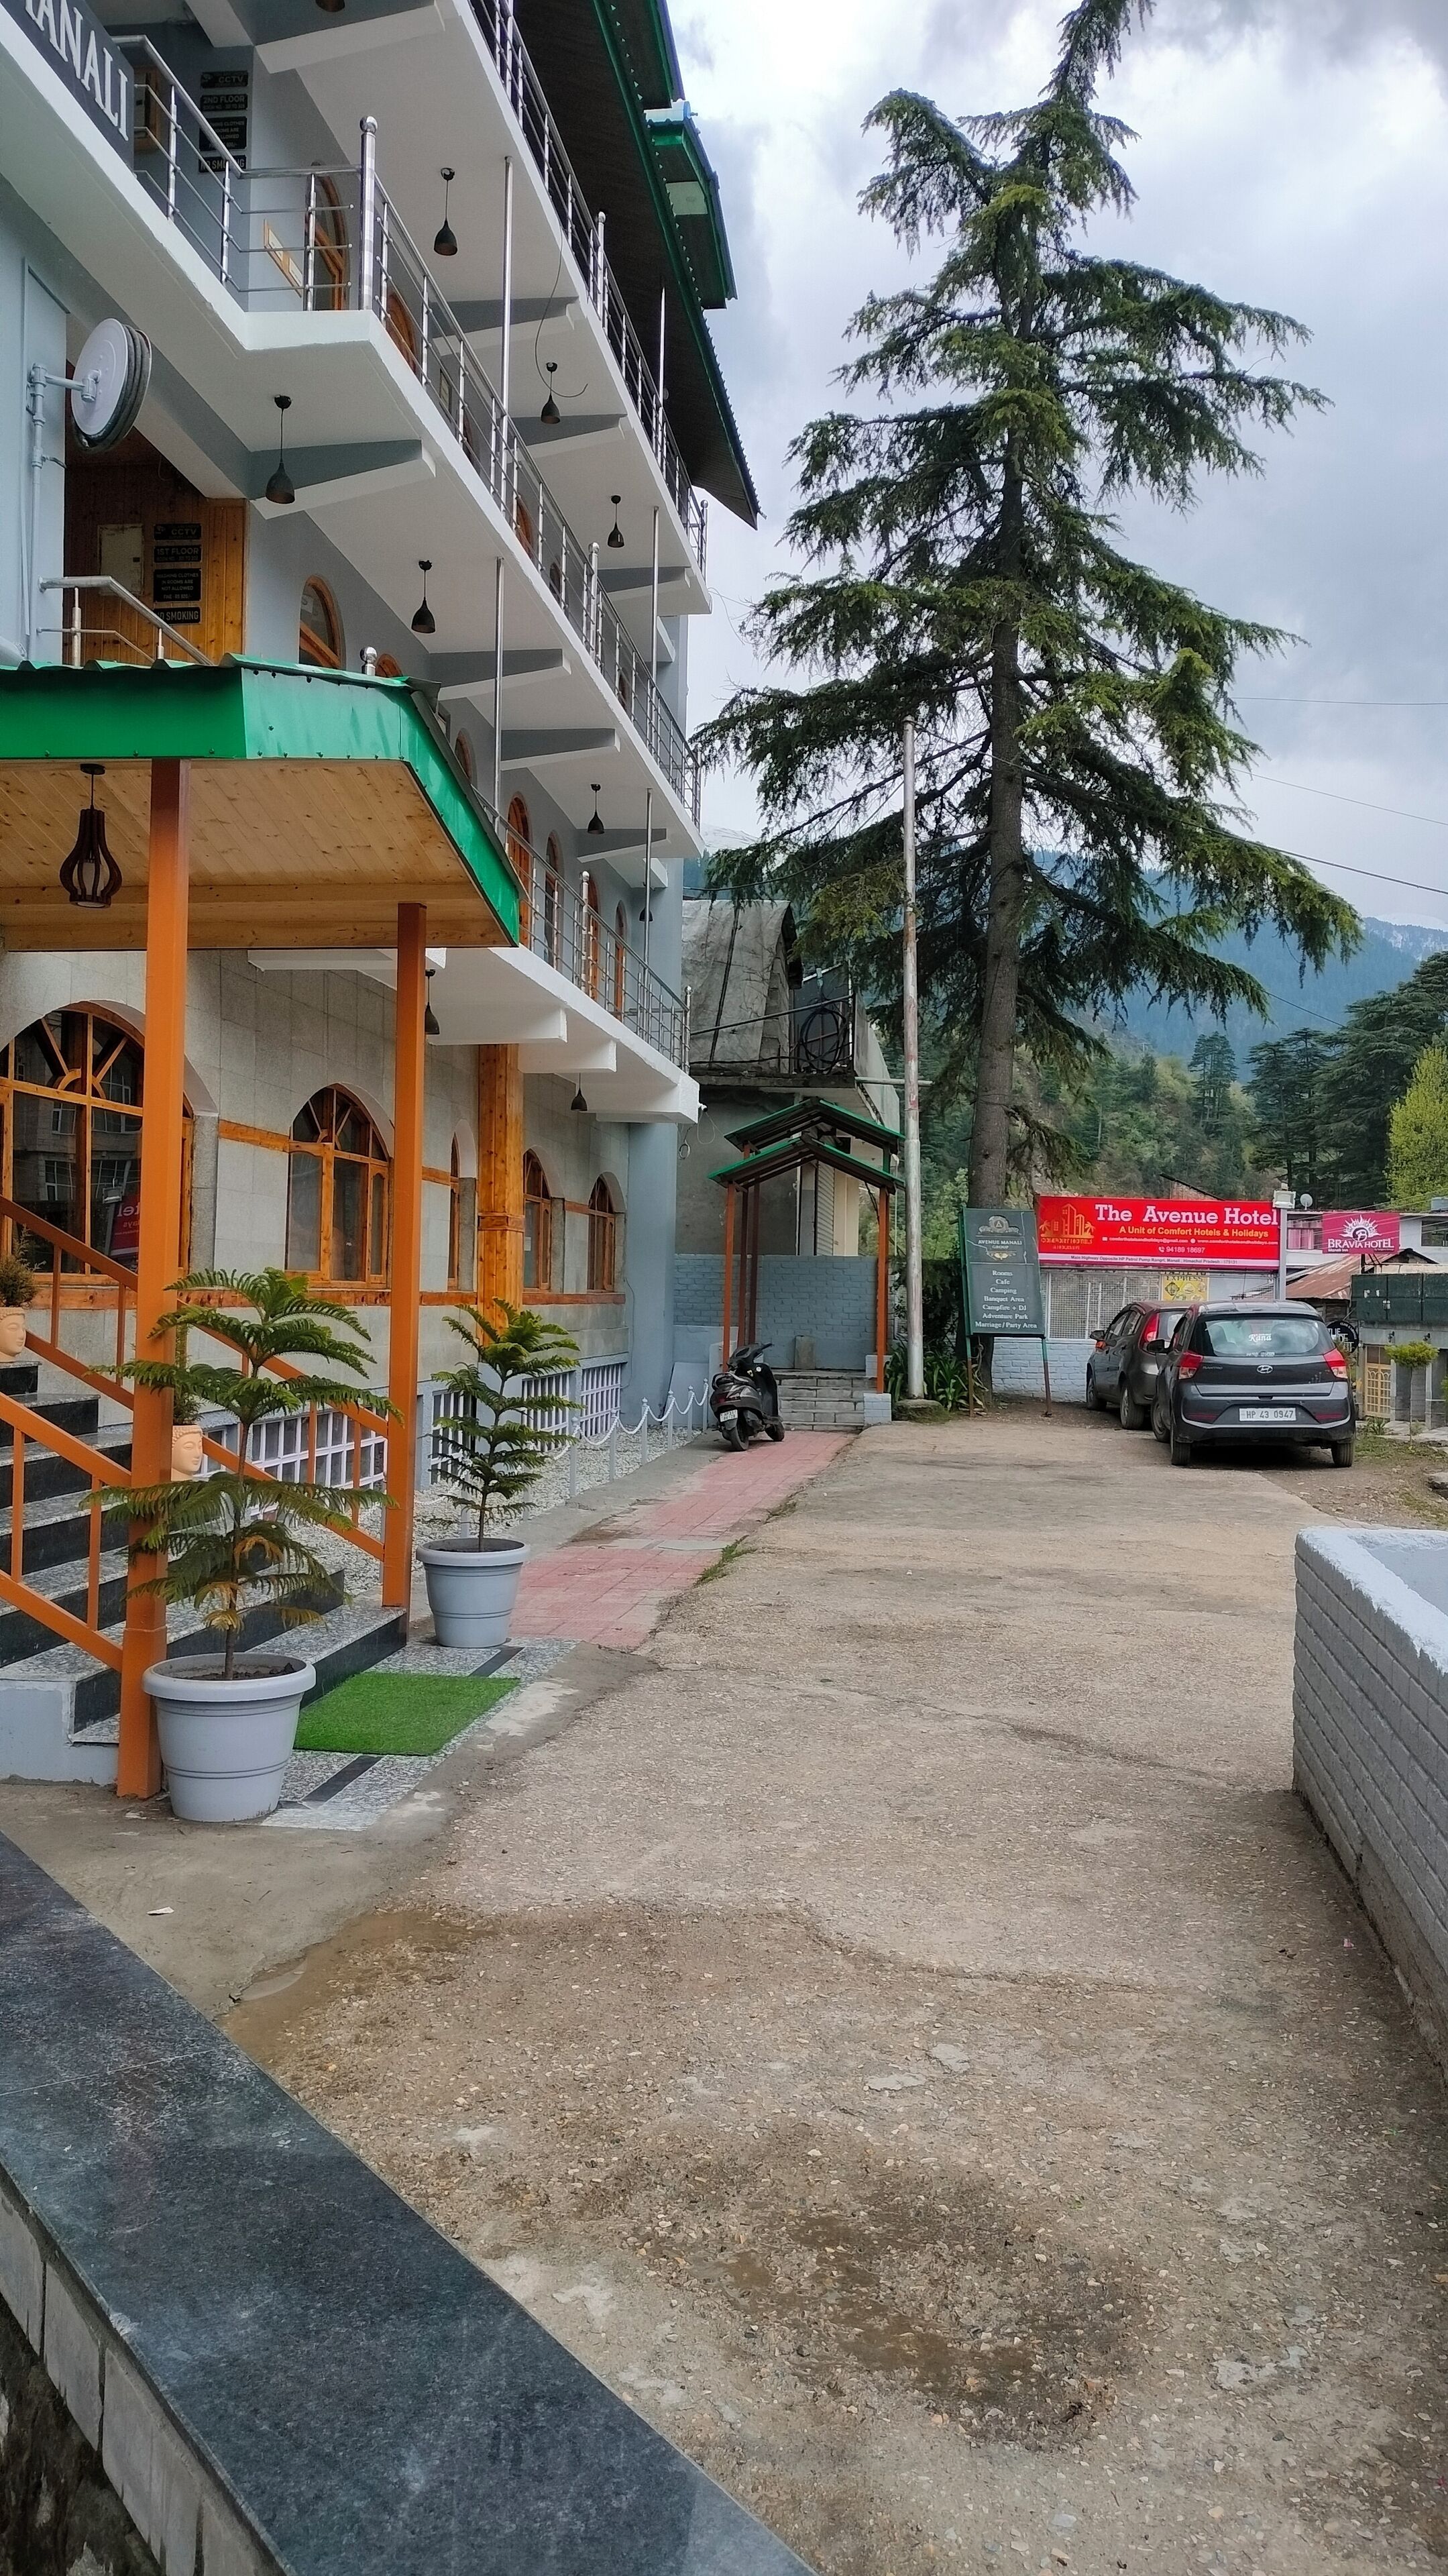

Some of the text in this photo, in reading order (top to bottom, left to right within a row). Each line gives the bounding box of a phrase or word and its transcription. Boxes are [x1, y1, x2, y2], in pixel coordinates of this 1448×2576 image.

[25, 0, 129, 141] ANALI
[220, 95, 245, 103] FLOOR
[157, 547, 199, 555] 1ST FLOOR
[166, 610, 199, 621] SMOKING
[1095, 1204, 1278, 1226] The Avenue Hotel
[1119, 1226, 1126, 1234] A
[1128, 1226, 1146, 1234] Unit
[1147, 1226, 1156, 1234] of
[1158, 1227, 1192, 1236] Comfort
[1194, 1228, 1221, 1236] Hotels
[1231, 1229, 1269, 1239] Holidays
[1328, 1238, 1395, 1248] BRAVIA HOTEL
[1249, 1334, 1272, 1342] Rana
[1246, 1410, 1294, 1419] HP 43 0947
